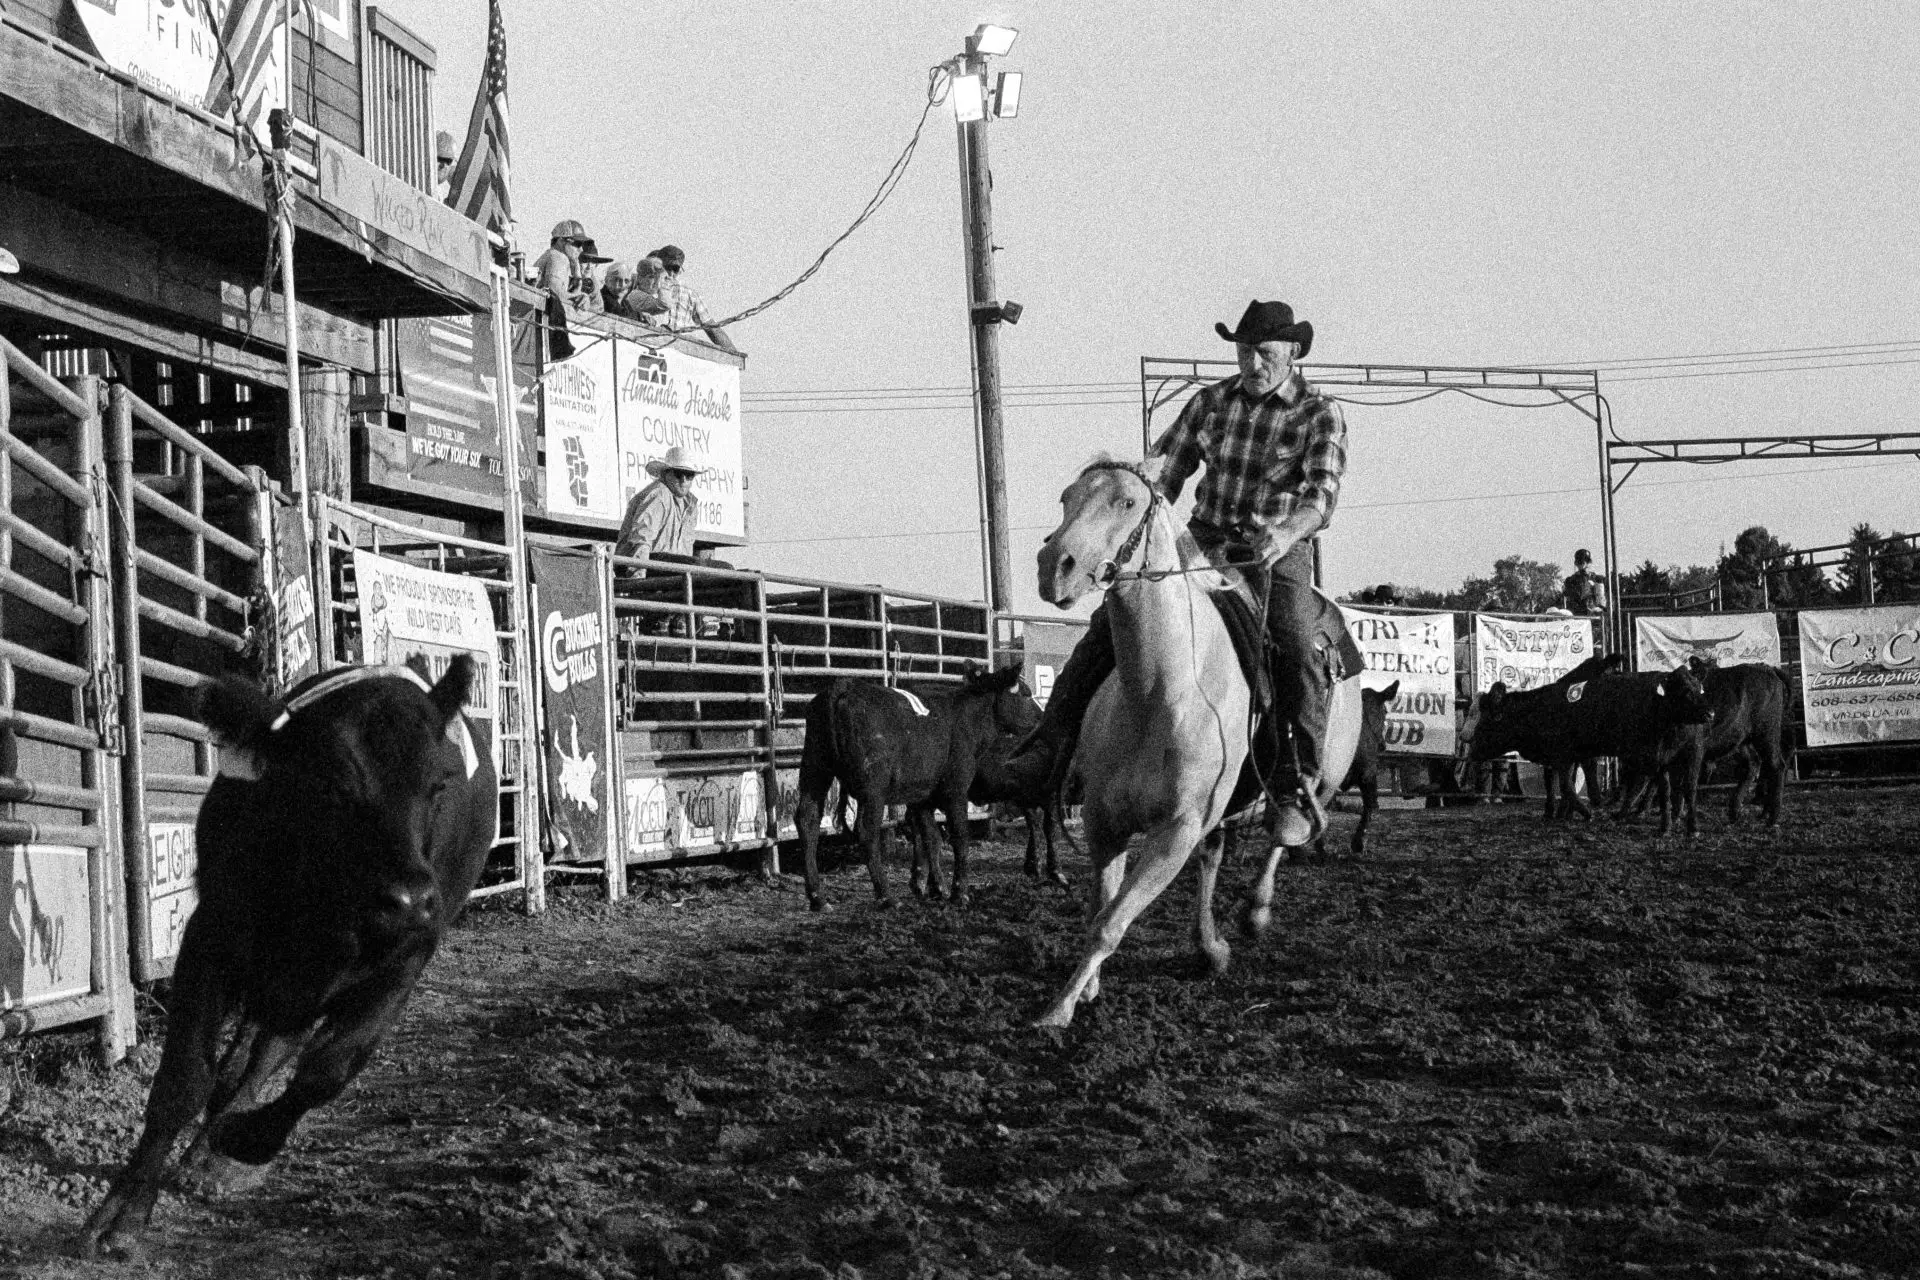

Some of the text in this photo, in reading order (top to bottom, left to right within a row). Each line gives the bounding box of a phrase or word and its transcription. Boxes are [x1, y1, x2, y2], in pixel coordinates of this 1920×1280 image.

[622, 368, 678, 409] Amanda
[434, 442, 451, 460] GOT
[450, 446, 470, 465] YOUR
[642, 416, 711, 454] COUNTRY
[382, 572, 397, 595] WE
[428, 583, 461, 607] SPONSOR
[406, 607, 462, 635] WILD WEST DAYS
[1480, 621, 1584, 660] Terry's
[1822, 632, 1860, 670] C
[1882, 629, 1920, 667] C
[567, 647, 598, 686] BULLS
[1811, 671, 1920, 688] Landscaping
